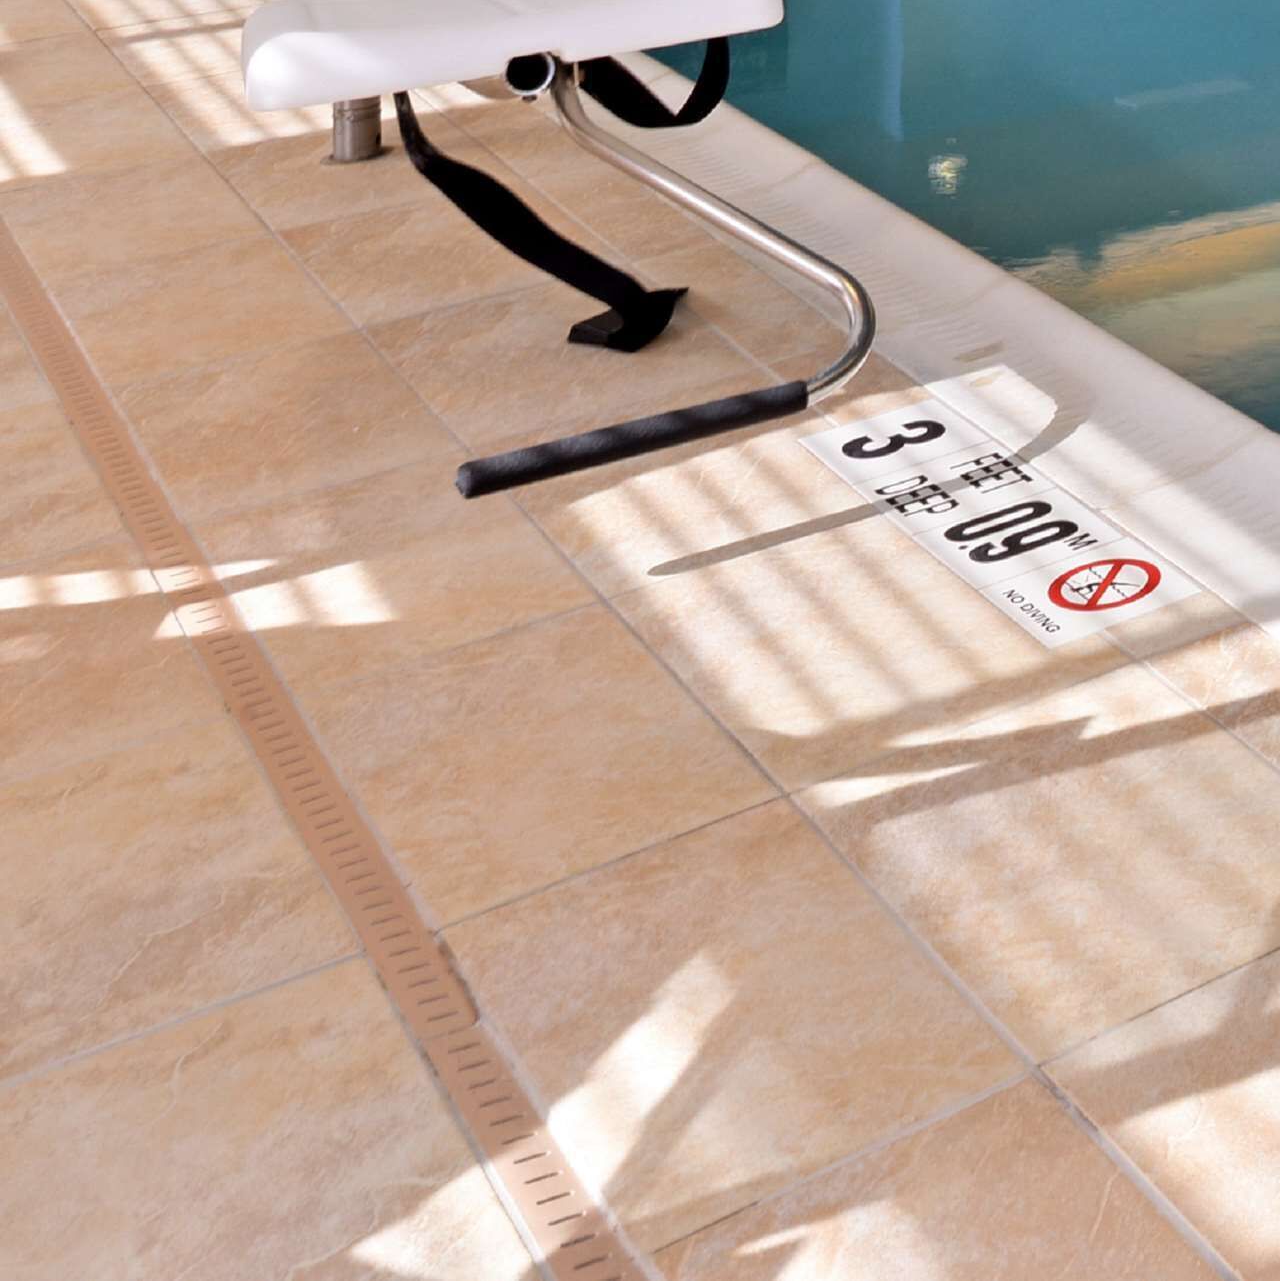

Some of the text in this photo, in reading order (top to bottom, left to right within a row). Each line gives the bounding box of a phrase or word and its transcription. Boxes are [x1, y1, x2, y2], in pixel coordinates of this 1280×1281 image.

[841, 420, 1033, 494] 3 FEET
[875, 475, 960, 517] DEEP
[1003, 589, 1061, 634] NO DIVING
